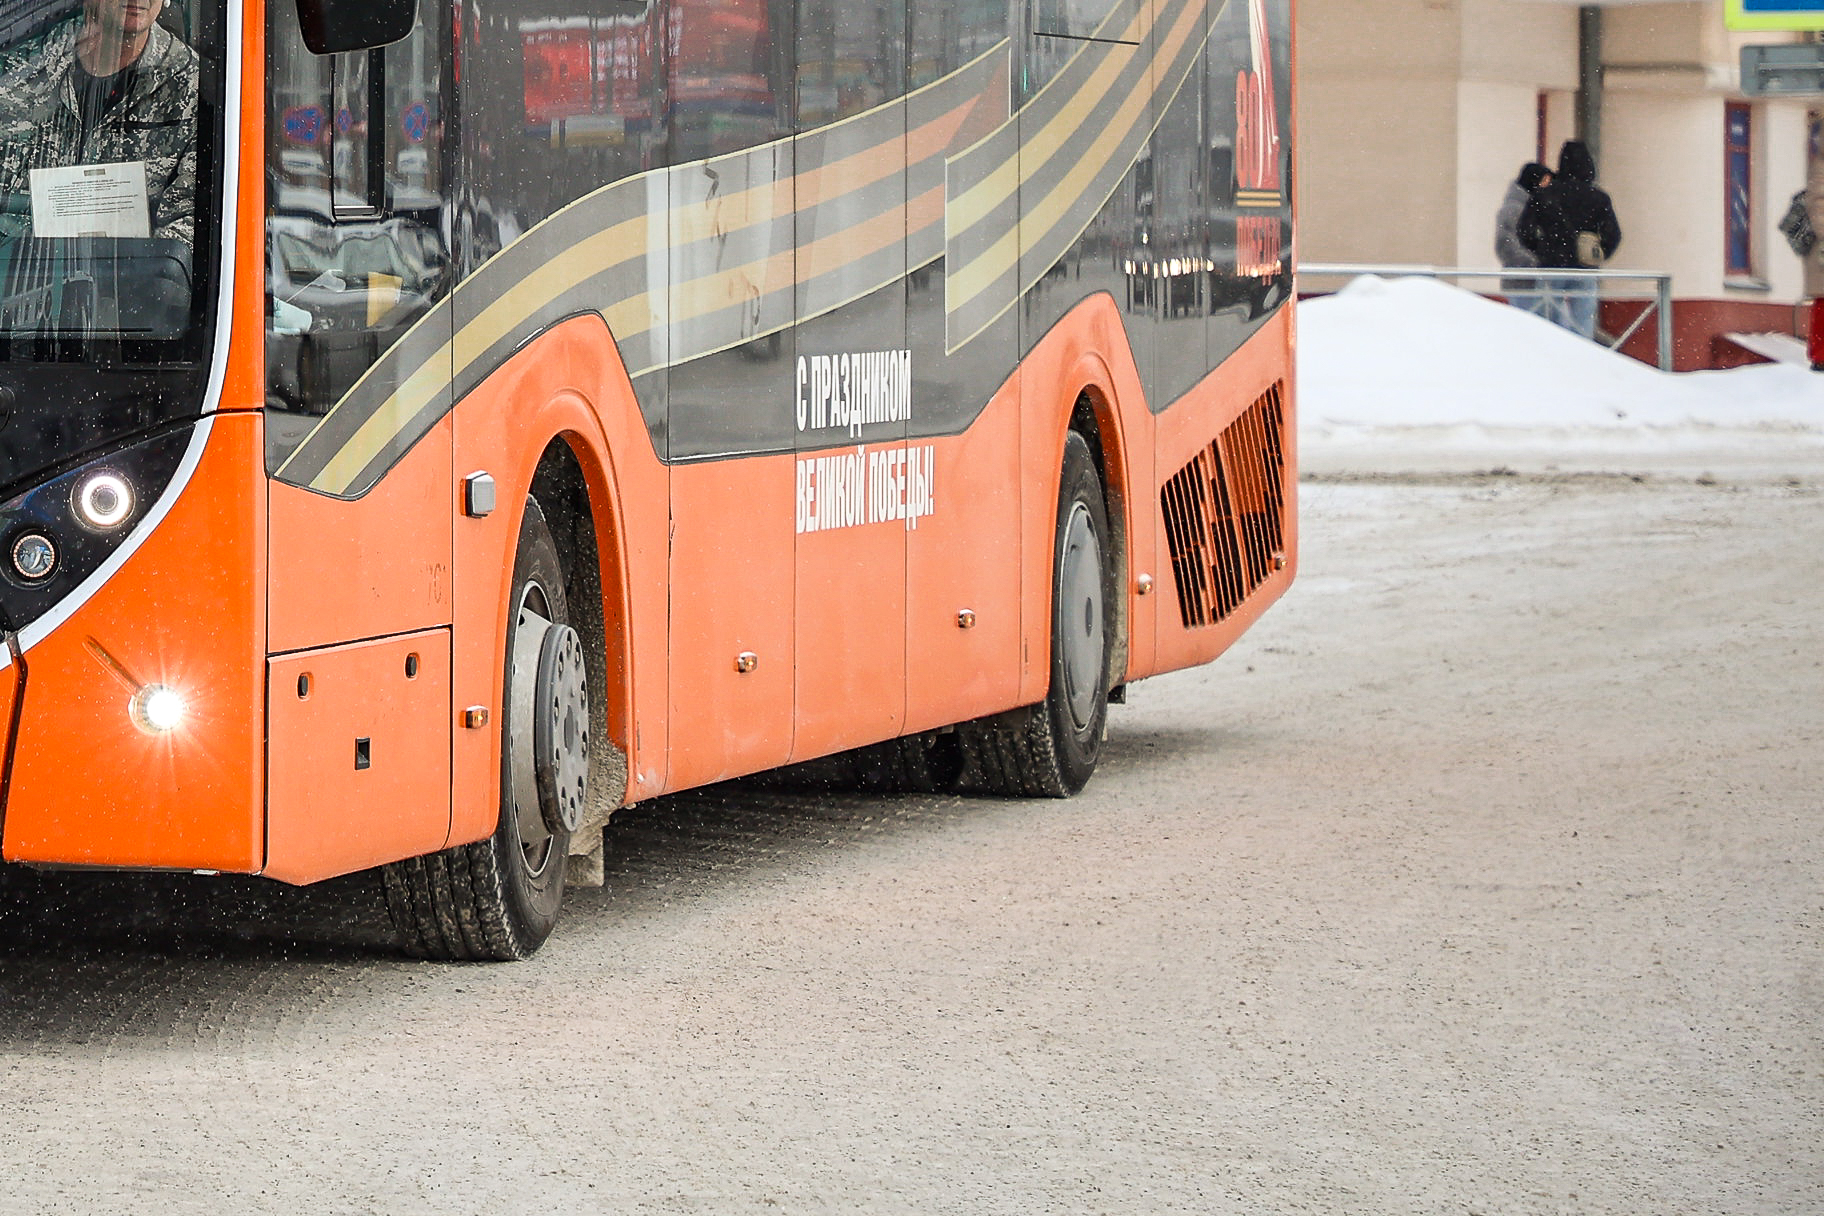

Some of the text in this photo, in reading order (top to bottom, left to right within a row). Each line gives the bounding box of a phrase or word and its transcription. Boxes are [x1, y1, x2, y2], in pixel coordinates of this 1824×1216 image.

[1236, 69, 1261, 189] 80
[796, 349, 912, 439] С ПРАЗДНИКОМ
[796, 445, 934, 534] ВЕЛИКОЙ ПОБЕДЫ!
